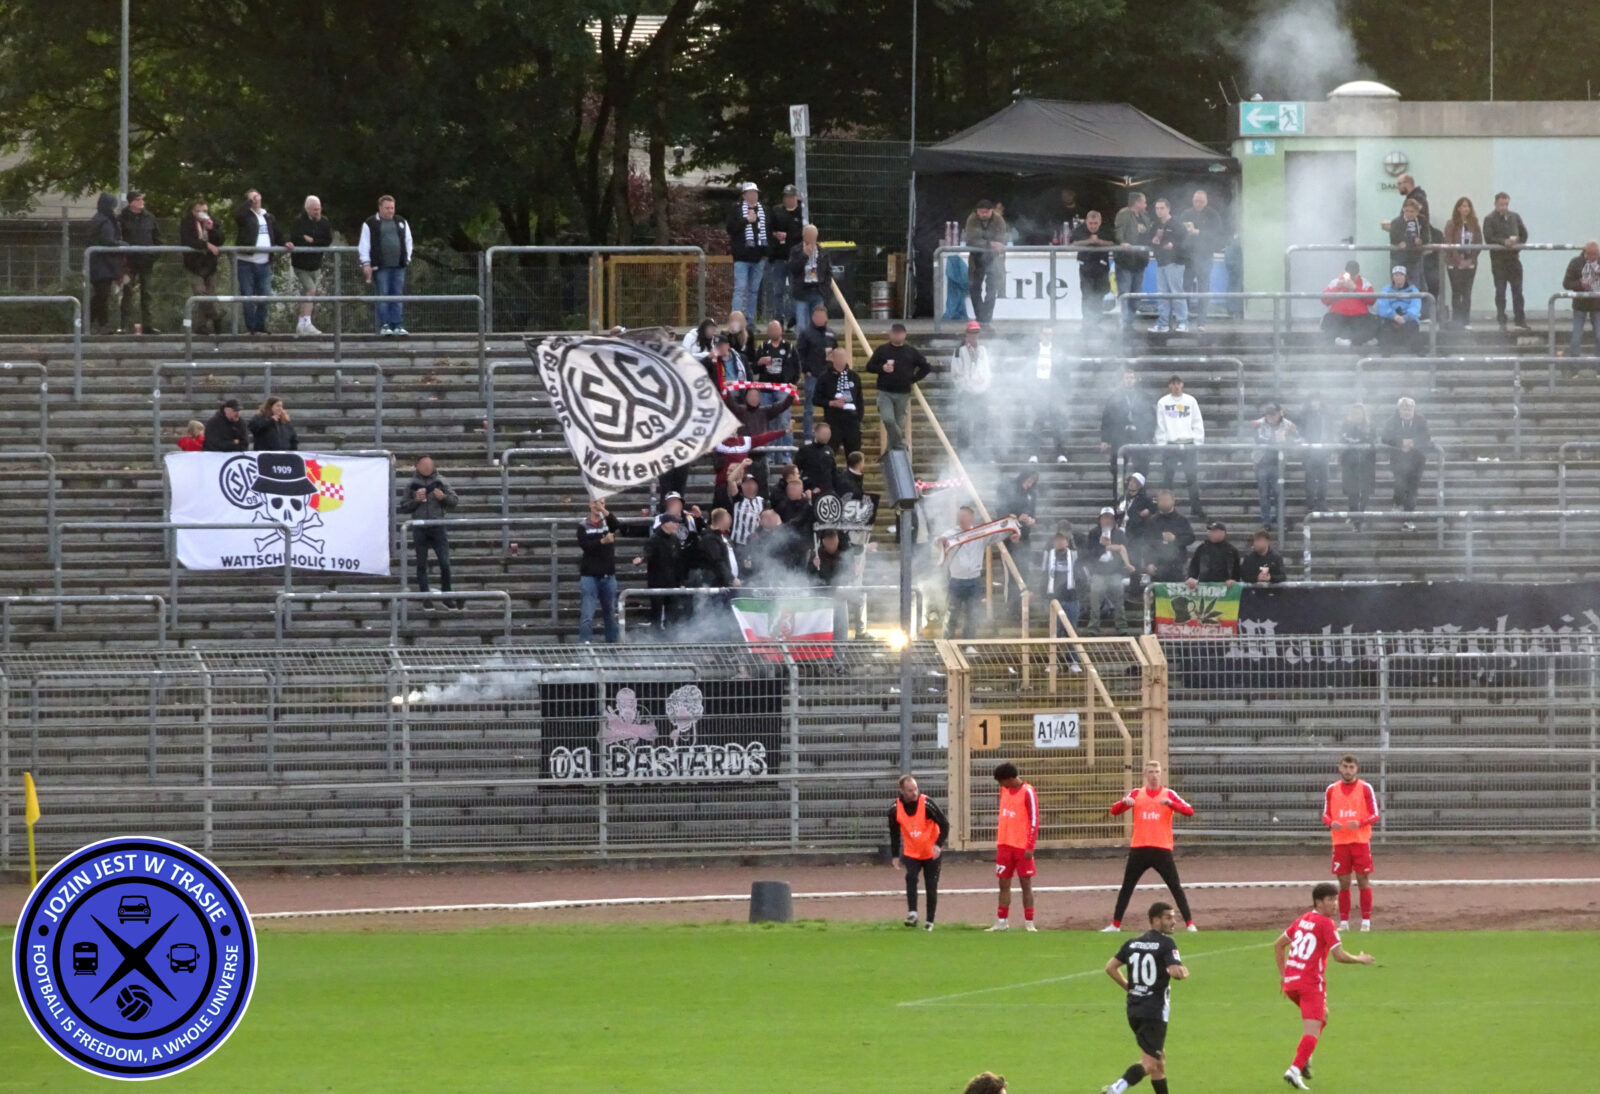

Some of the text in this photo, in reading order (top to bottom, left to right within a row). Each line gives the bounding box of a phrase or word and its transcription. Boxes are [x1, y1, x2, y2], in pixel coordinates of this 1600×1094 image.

[583, 406, 716, 480] Wattenscheid
[693, 374, 713, 400] 09
[636, 414, 666, 440] 09
[271, 465, 292, 474] 1909
[246, 496, 258, 505] 09
[221, 553, 360, 570] WATTSCHHOLIC 1909
[979, 719, 988, 745] 1
[1037, 720, 1077, 740] A1/A2
[550, 741, 768, 782] 09 BASTARDS
[1288, 929, 1317, 960] 30
[1128, 952, 1157, 986] 10
